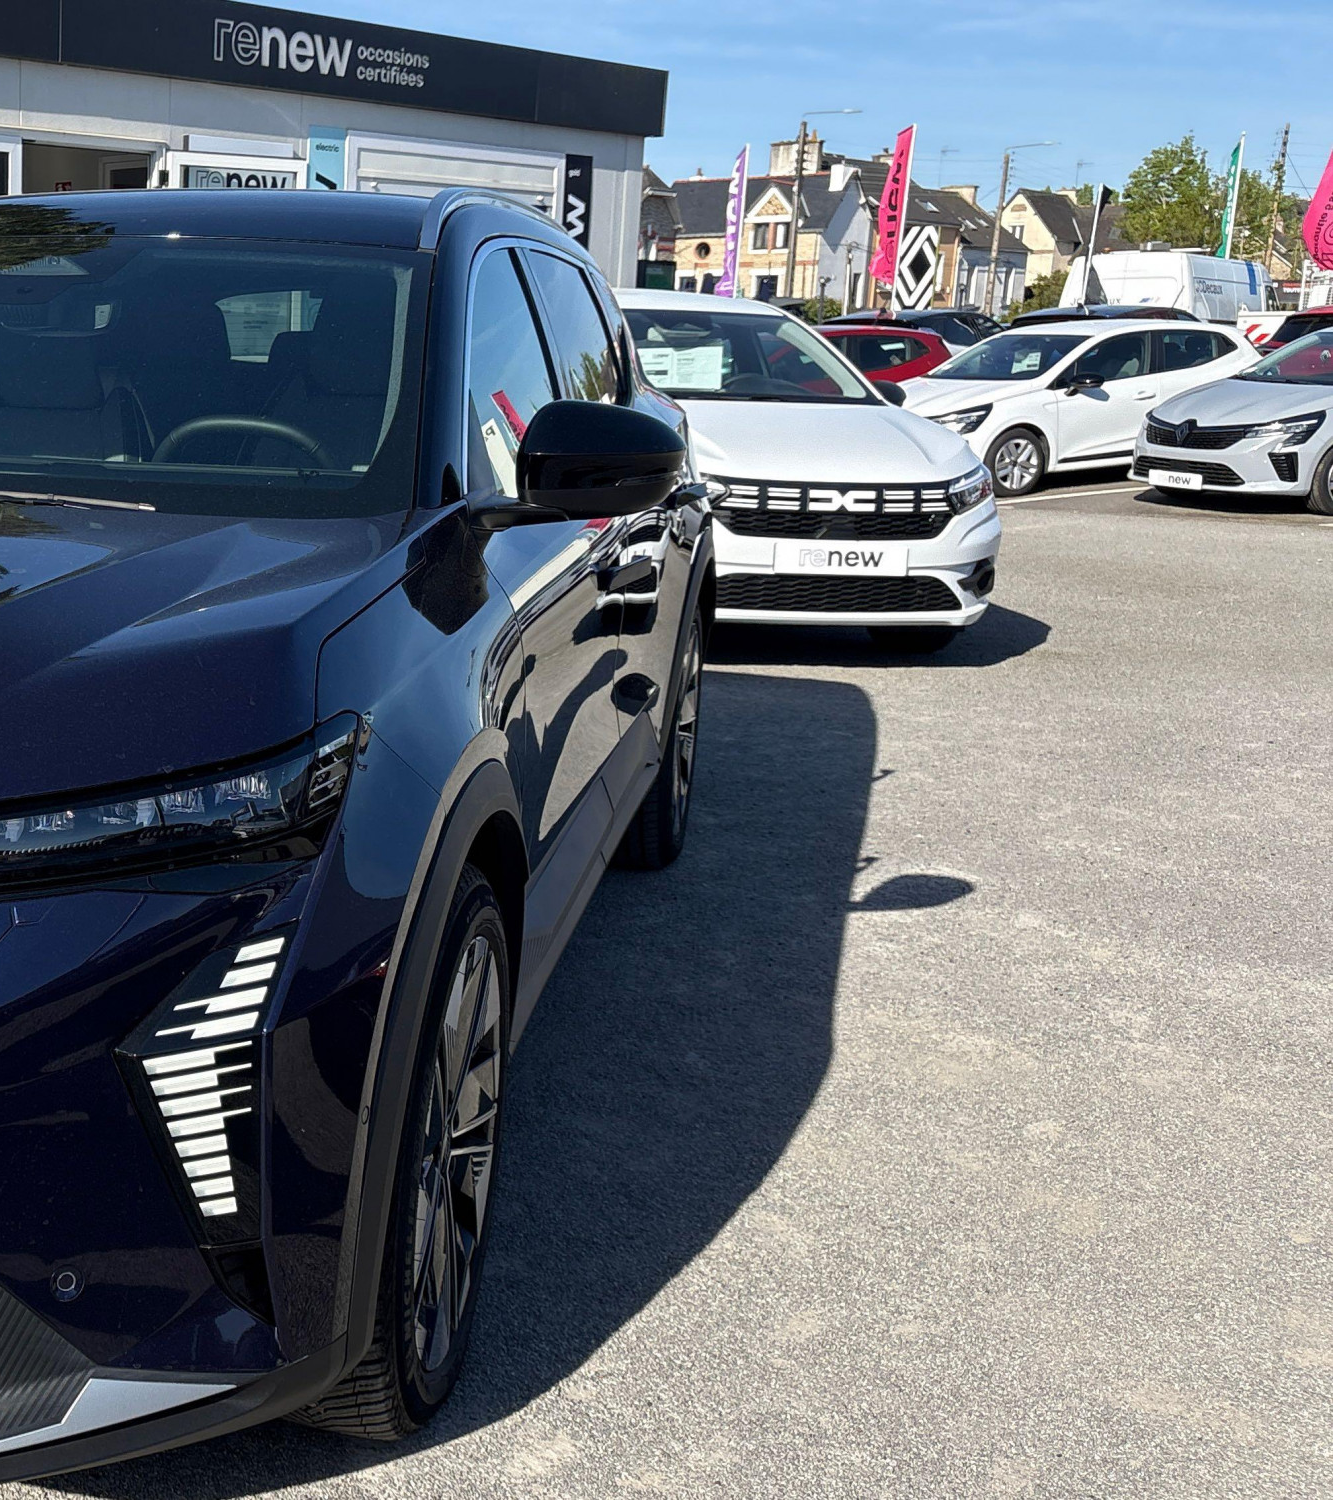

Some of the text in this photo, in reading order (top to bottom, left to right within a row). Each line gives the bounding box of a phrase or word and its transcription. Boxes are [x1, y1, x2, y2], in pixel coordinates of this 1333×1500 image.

[213, 18, 354, 78] renew
[356, 45, 430, 69] occasions
[356, 65, 425, 88] certifiées
[315, 142, 340, 153] electric
[798, 548, 884, 568] renew
